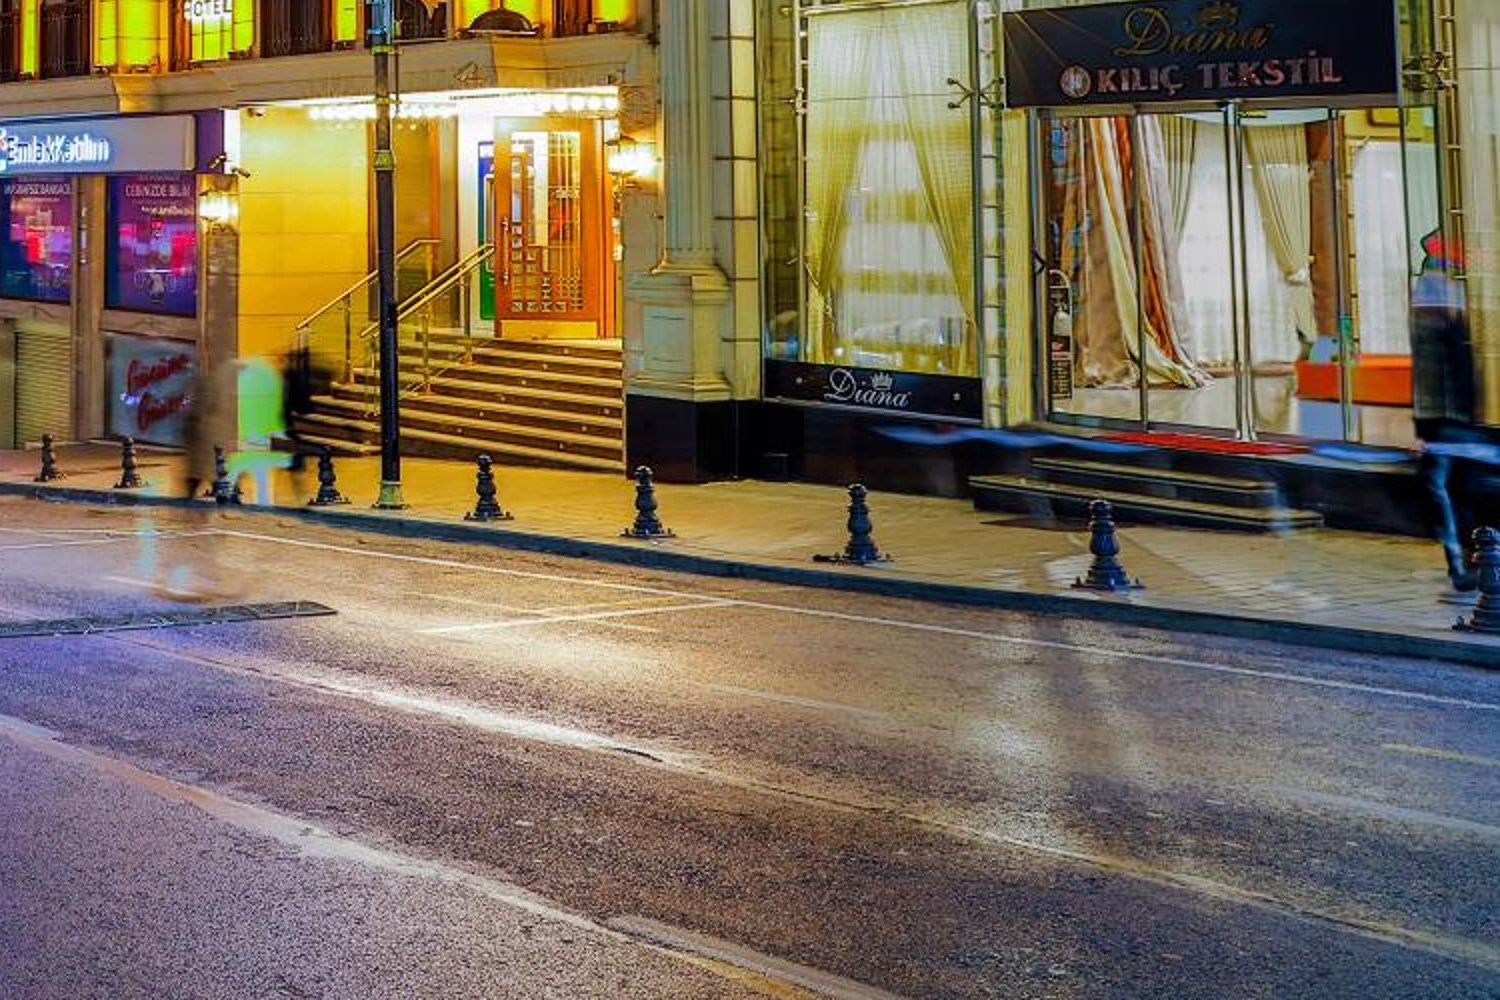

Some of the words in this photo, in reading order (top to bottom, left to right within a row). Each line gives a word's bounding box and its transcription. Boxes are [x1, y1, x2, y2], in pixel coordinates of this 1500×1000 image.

[1098, 63, 1187, 95] KILIÇ
[1199, 50, 1344, 90] TEKSTİL
[823, 367, 911, 408] Diana
